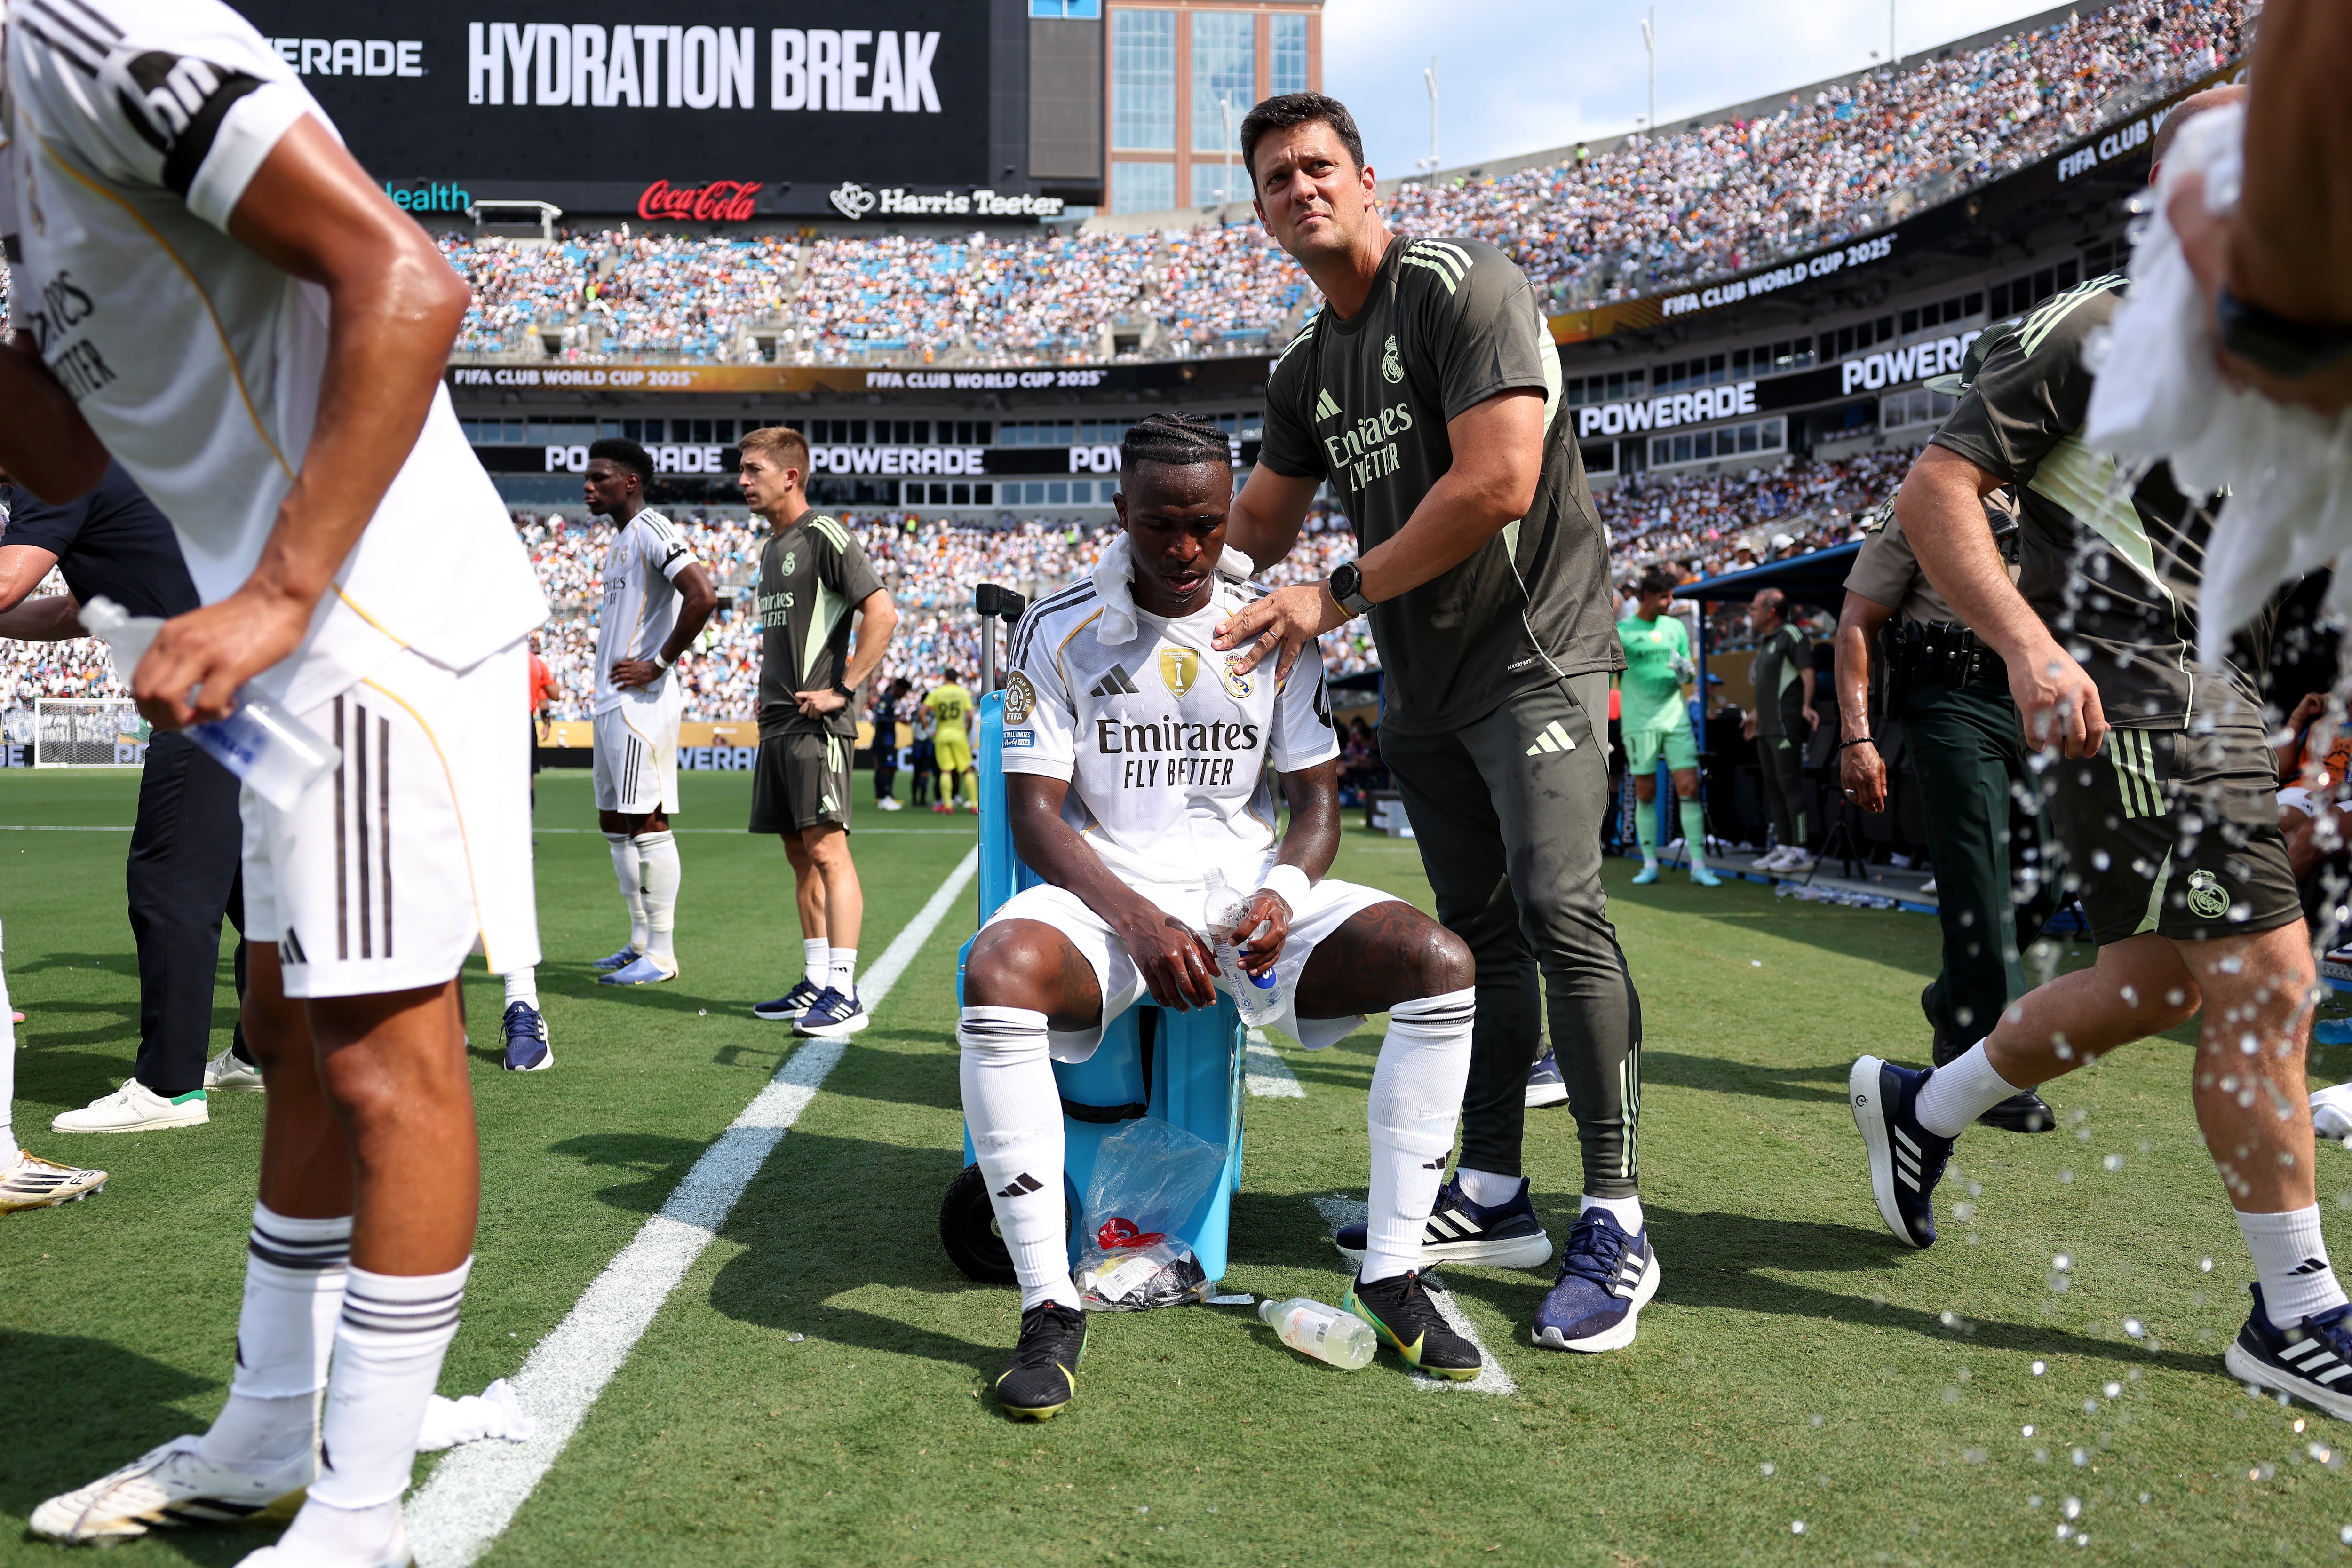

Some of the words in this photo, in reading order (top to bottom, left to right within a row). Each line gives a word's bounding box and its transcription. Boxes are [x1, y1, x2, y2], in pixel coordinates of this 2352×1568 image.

[264, 37, 423, 77] ERADE
[469, 22, 754, 109] HYDRATION
[772, 29, 941, 112] BREAK
[2058, 145, 2098, 182] FIFA
[2099, 119, 2149, 161] CLUB
[879, 188, 969, 214] Harris
[973, 190, 1064, 216] Teeter
[1662, 293, 1700, 317] FIFA
[1702, 281, 1747, 308] CLUB
[1748, 262, 1808, 296] WORLD
[1809, 250, 1845, 277] CUP
[1842, 326, 1992, 396] POWER
[454, 369, 492, 385] FIFA
[495, 369, 540, 385] CLUB
[542, 369, 605, 385] WORLD
[609, 370, 645, 385] CUP
[866, 372, 904, 388] FIFA
[906, 372, 952, 388] CLUB
[954, 372, 1017, 389] WORLD
[1019, 372, 1055, 388] CUP
[1579, 380, 1757, 438] POWERADE
[546, 445, 722, 472] PORADE
[809, 447, 984, 474] POWERADE
[1507, 658, 1532, 671] AEROREADY
[1007, 677, 1016, 688] ORLD
[1016, 677, 1027, 687] CUP
[1025, 688, 1031, 697] 25
[1022, 698, 1032, 712] USA
[1096, 715, 1258, 753] Emirates
[1124, 759, 1160, 789] FLY
[1167, 757, 1234, 786] BETTER
[1236, 980, 1245, 997] RECYCLE
